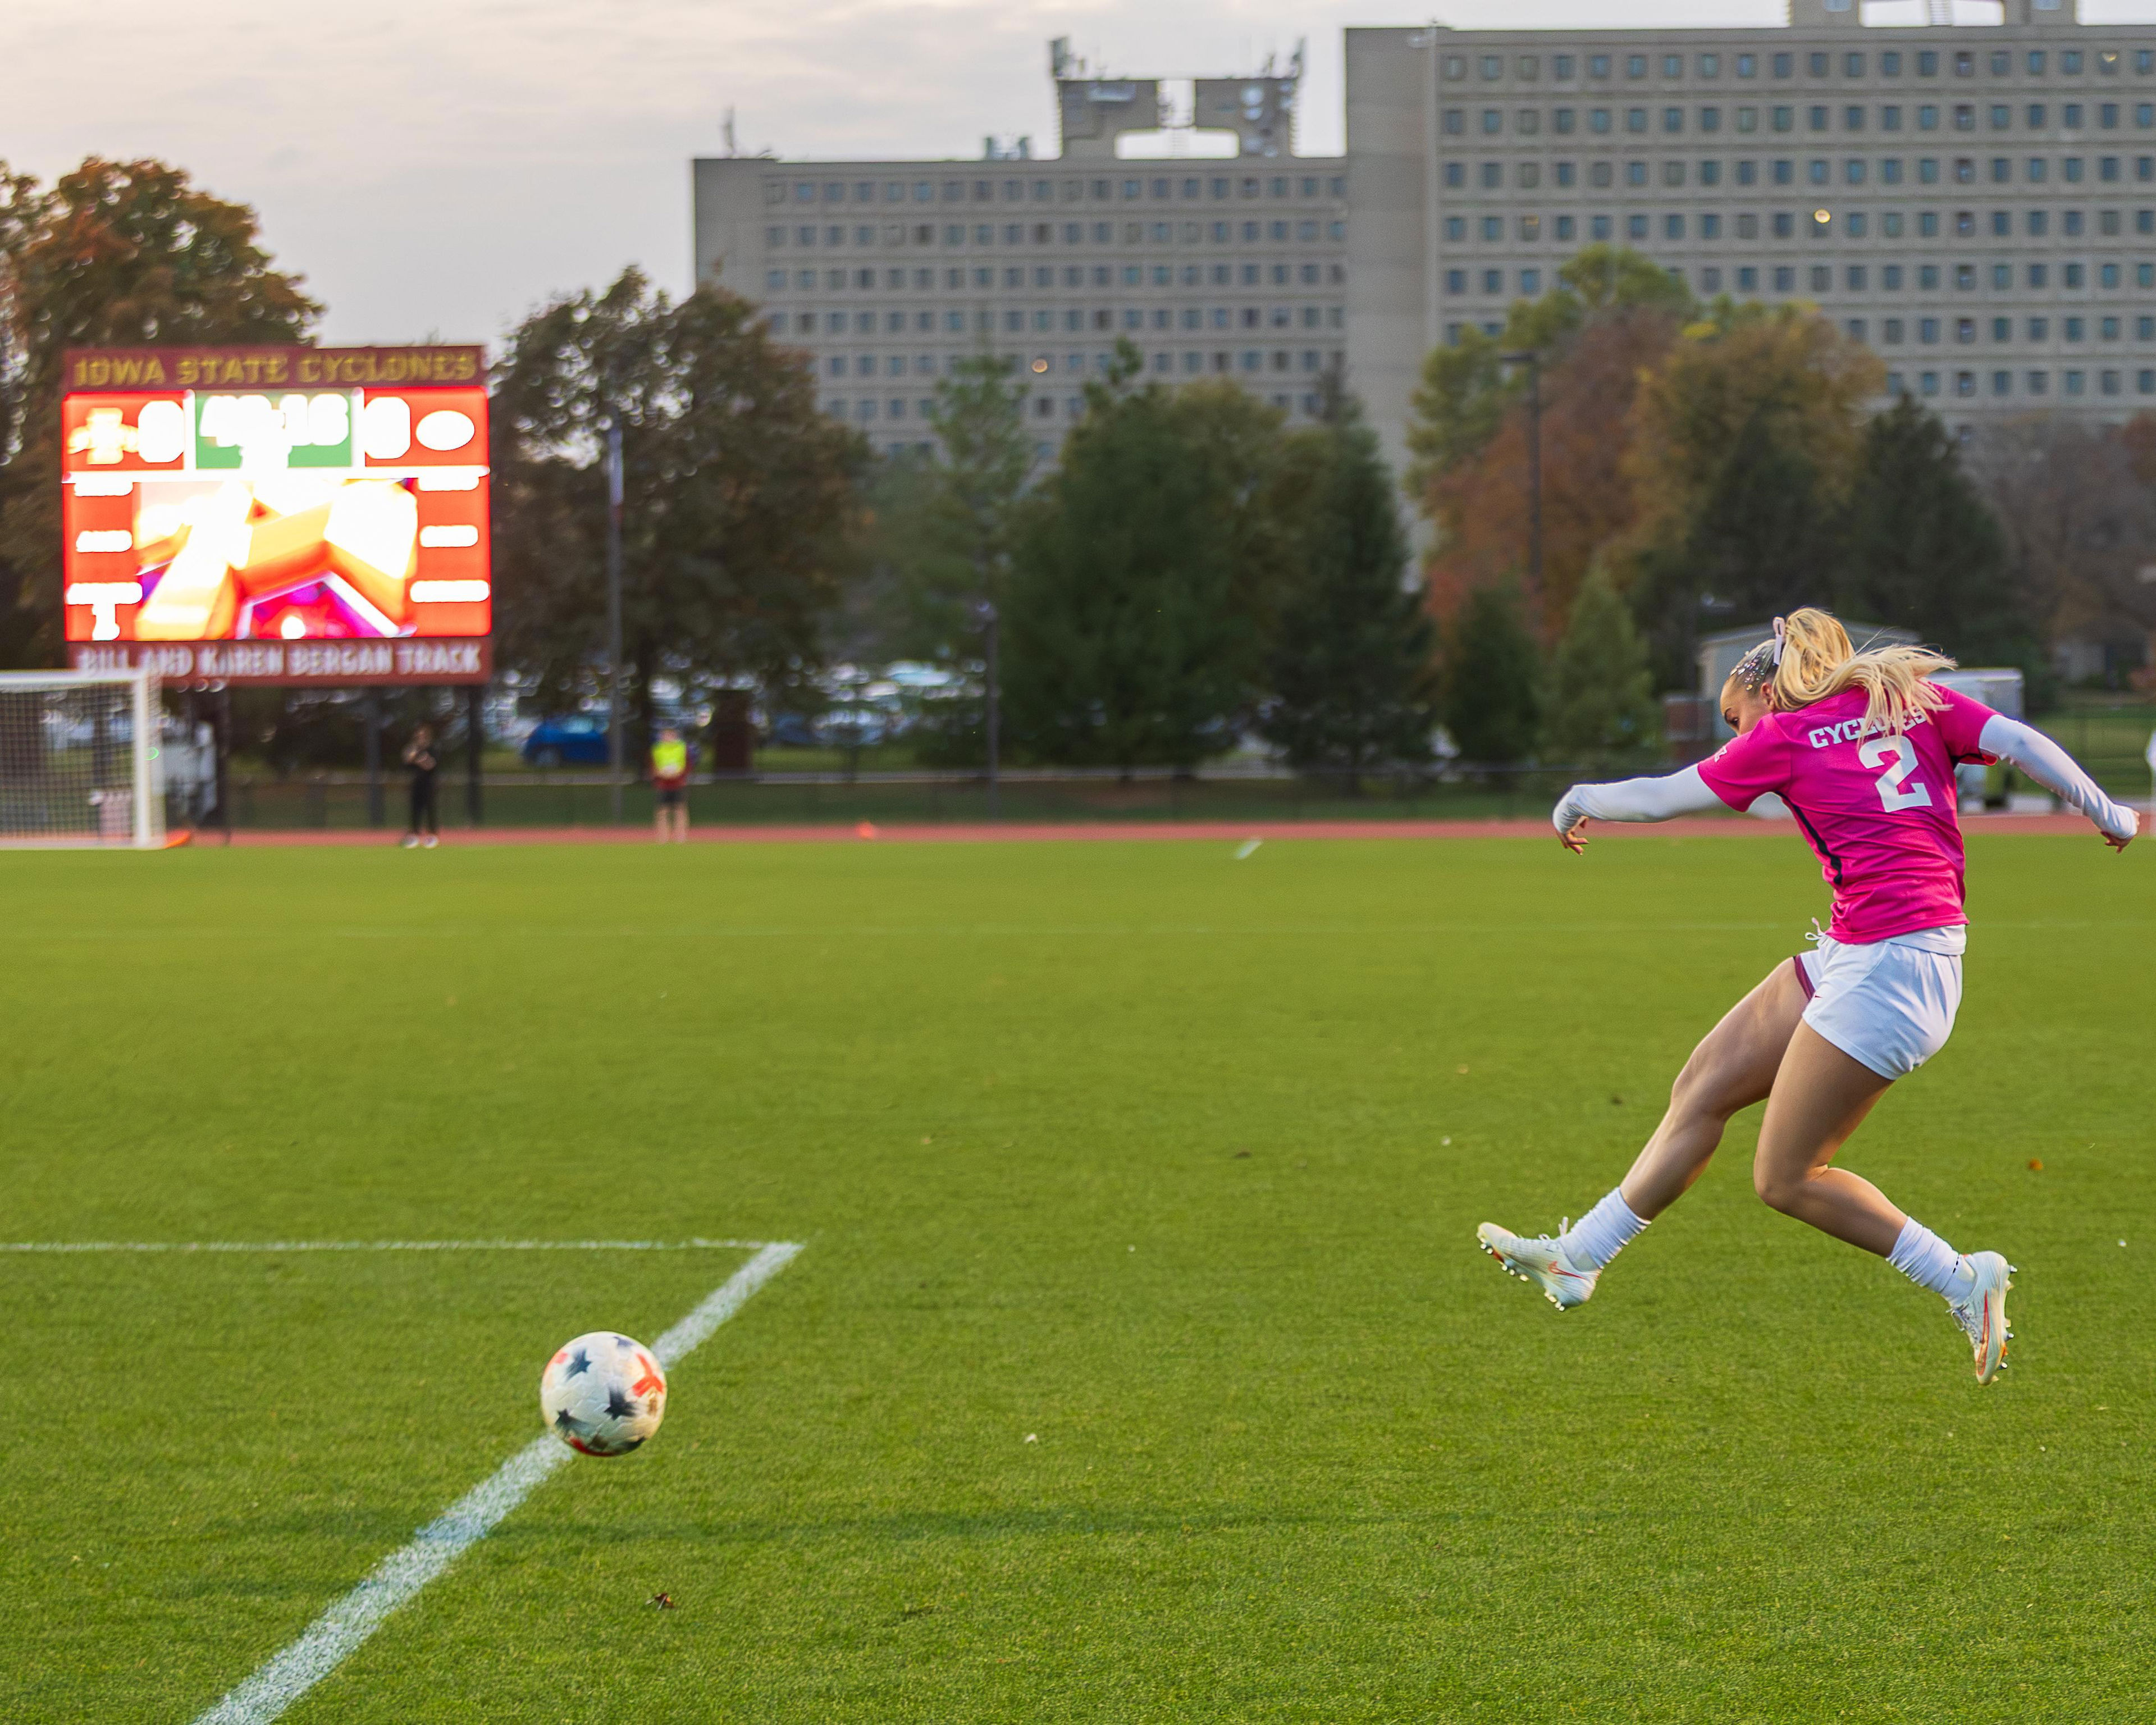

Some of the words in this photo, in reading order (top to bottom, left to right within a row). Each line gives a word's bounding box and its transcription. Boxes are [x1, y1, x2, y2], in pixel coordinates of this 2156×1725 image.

[75, 356, 165, 386] IOWA
[175, 354, 288, 384] STATE
[298, 351, 477, 383] CYCLONES
[77, 648, 133, 674] BILL
[139, 647, 193, 677] AND
[198, 646, 282, 676] KAREN
[287, 645, 392, 676] BERGAN
[396, 644, 481, 674] TRACK
[1808, 705, 1927, 749] CYCLOES
[1858, 735, 1933, 813] 2
